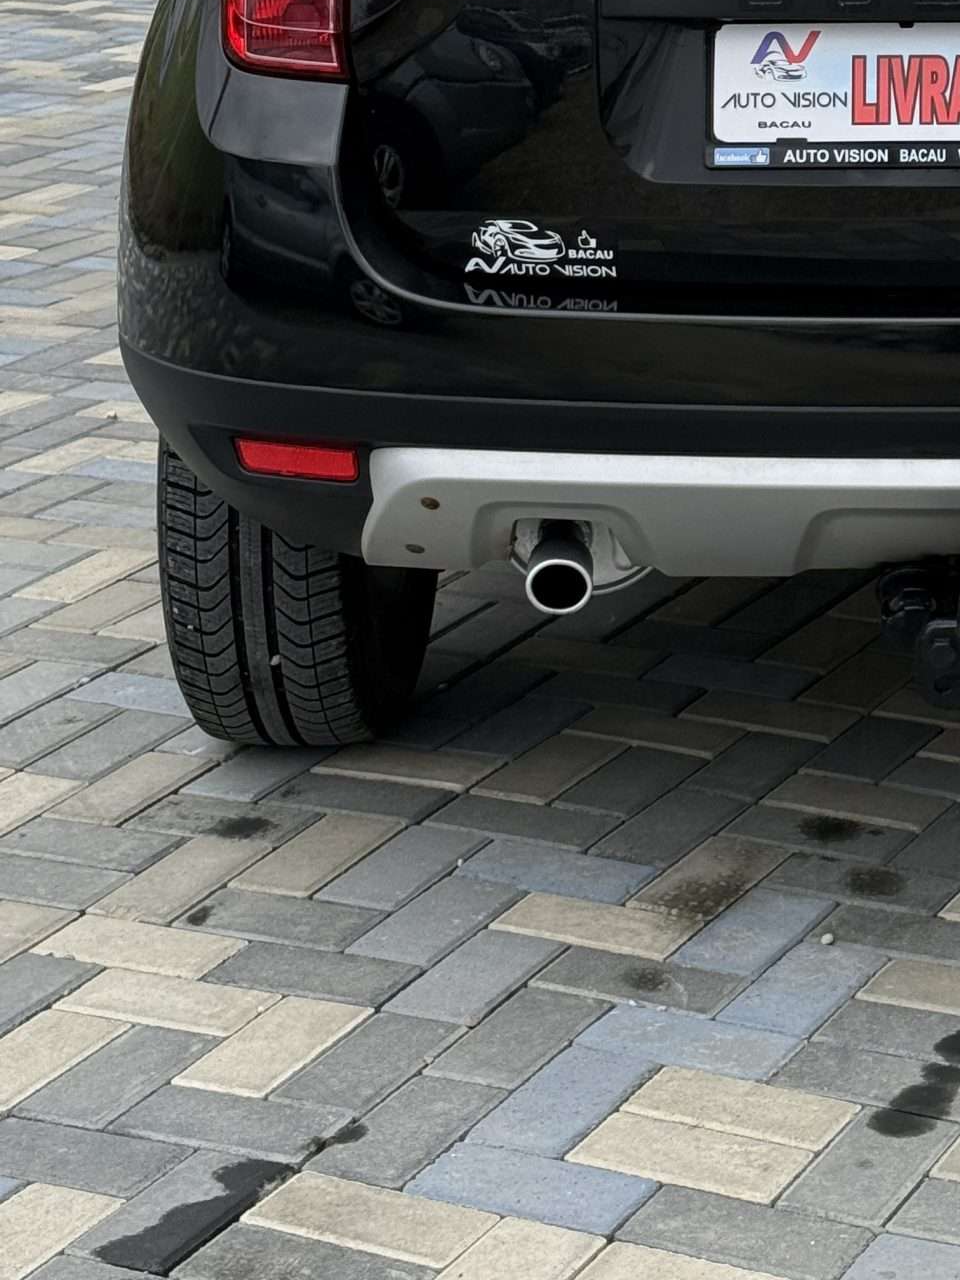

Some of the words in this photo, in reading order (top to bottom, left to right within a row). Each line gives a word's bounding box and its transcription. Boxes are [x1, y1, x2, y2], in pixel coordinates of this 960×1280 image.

[721, 92, 776, 109] AUTO
[781, 91, 848, 108] VISION
[758, 121, 812, 129] BACAU
[783, 149, 830, 163] AUTO
[833, 149, 889, 163] VISION
[899, 149, 947, 163] BACAU
[568, 249, 614, 260] BACAU
[500, 263, 550, 276] AUTO
[553, 263, 617, 277] VISION
